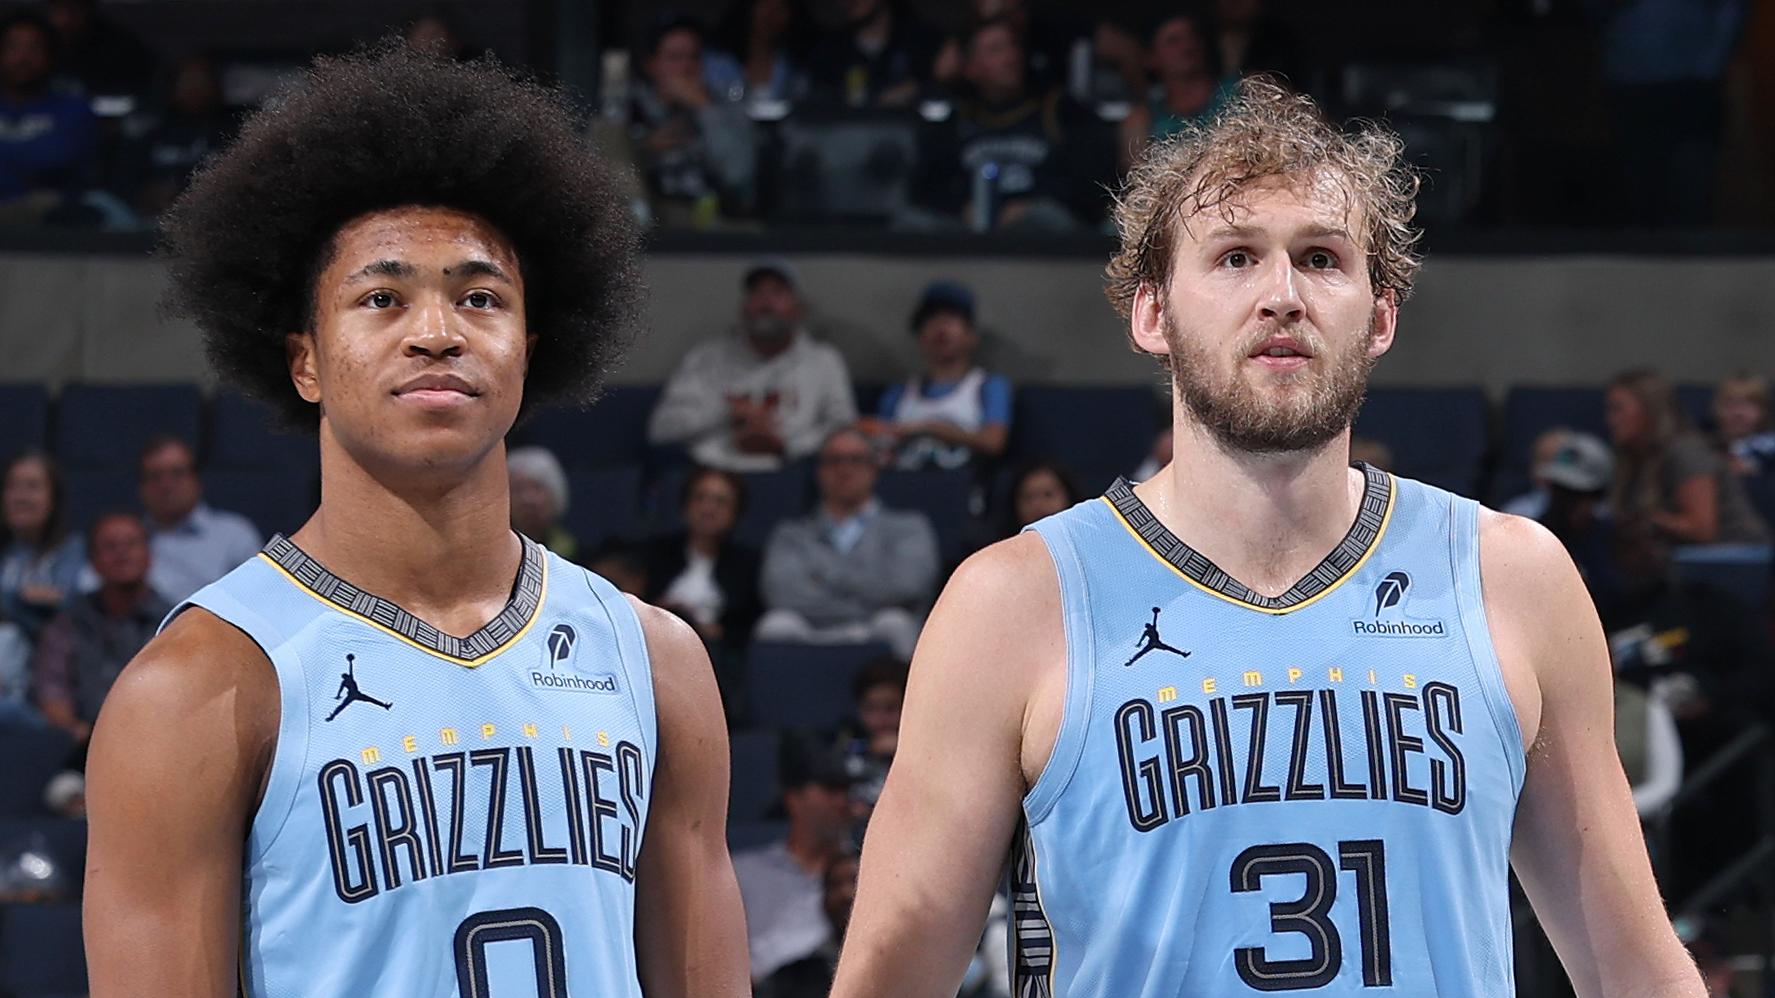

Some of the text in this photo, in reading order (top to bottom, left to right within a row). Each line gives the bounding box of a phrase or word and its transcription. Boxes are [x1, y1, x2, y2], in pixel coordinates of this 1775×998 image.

[532, 670, 616, 692] Robinhood
[1353, 620, 1444, 636] Robinhood
[317, 740, 644, 904] GRIZZLIES
[1113, 681, 1467, 833] GRIZZLIES
[1229, 839, 1394, 992] 31
